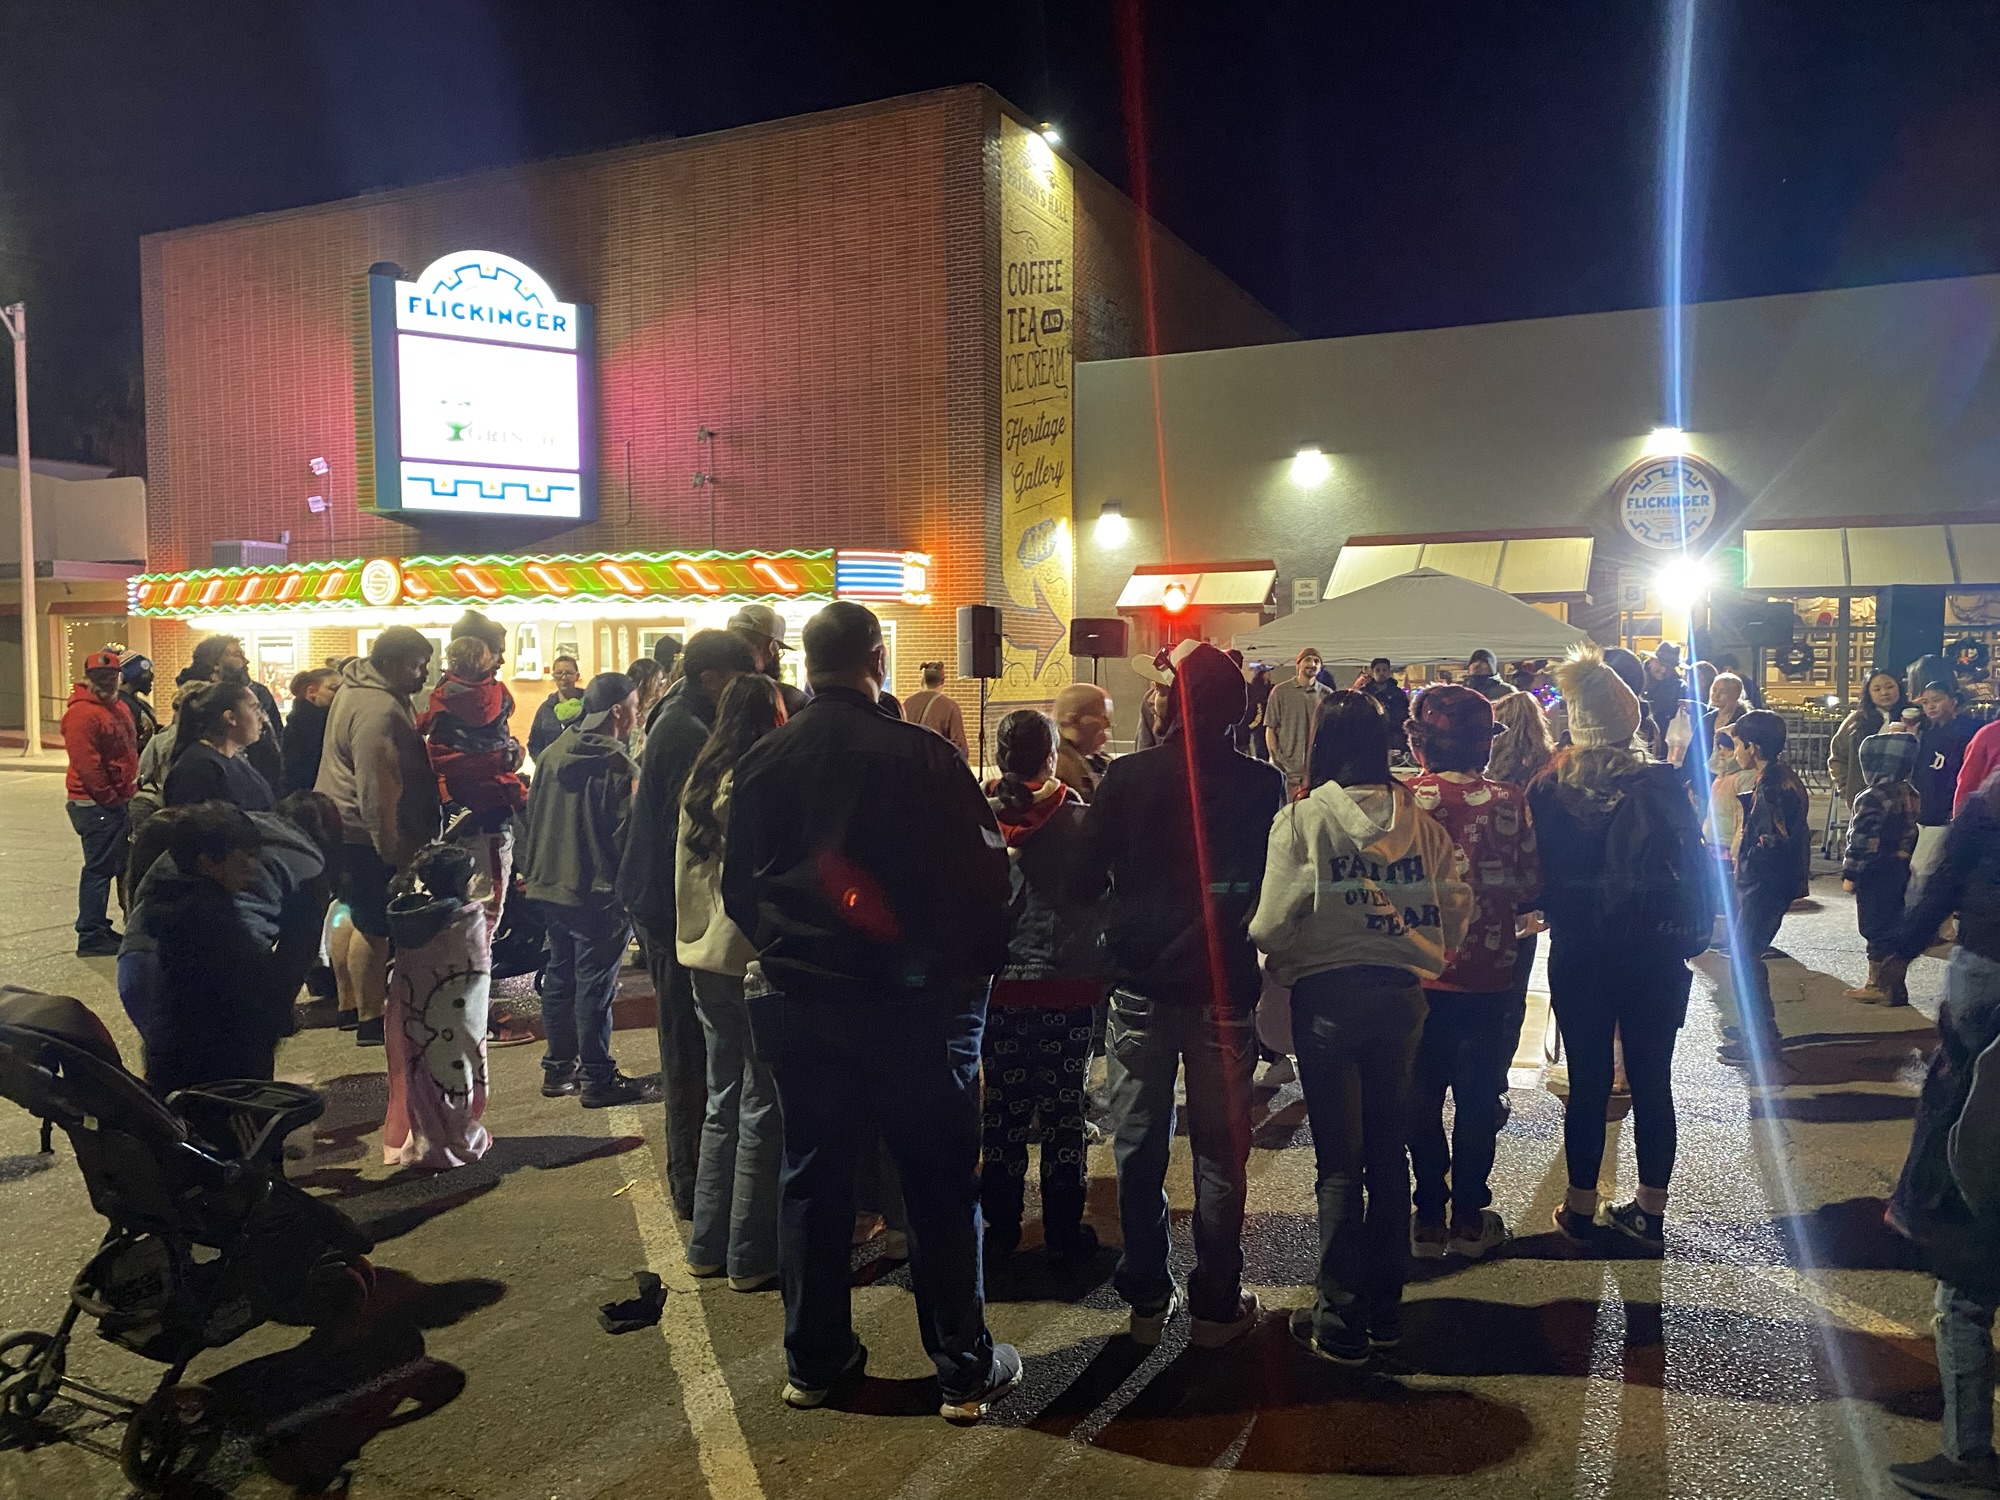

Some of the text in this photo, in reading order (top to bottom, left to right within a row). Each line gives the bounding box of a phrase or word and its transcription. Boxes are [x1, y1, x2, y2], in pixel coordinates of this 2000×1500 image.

[1007, 259, 1063, 297] COFFEE
[408, 296, 567, 332] FLICKINGER
[1007, 307, 1062, 347] TEA AND
[1005, 346, 1068, 398] ICE CREAM
[1006, 412, 1066, 456] Heritage
[1012, 456, 1064, 504] Gallery
[1627, 495, 1709, 508] FLICKINGER
[1329, 854, 1425, 884] FAITH
[1365, 904, 1442, 936] FEAR
